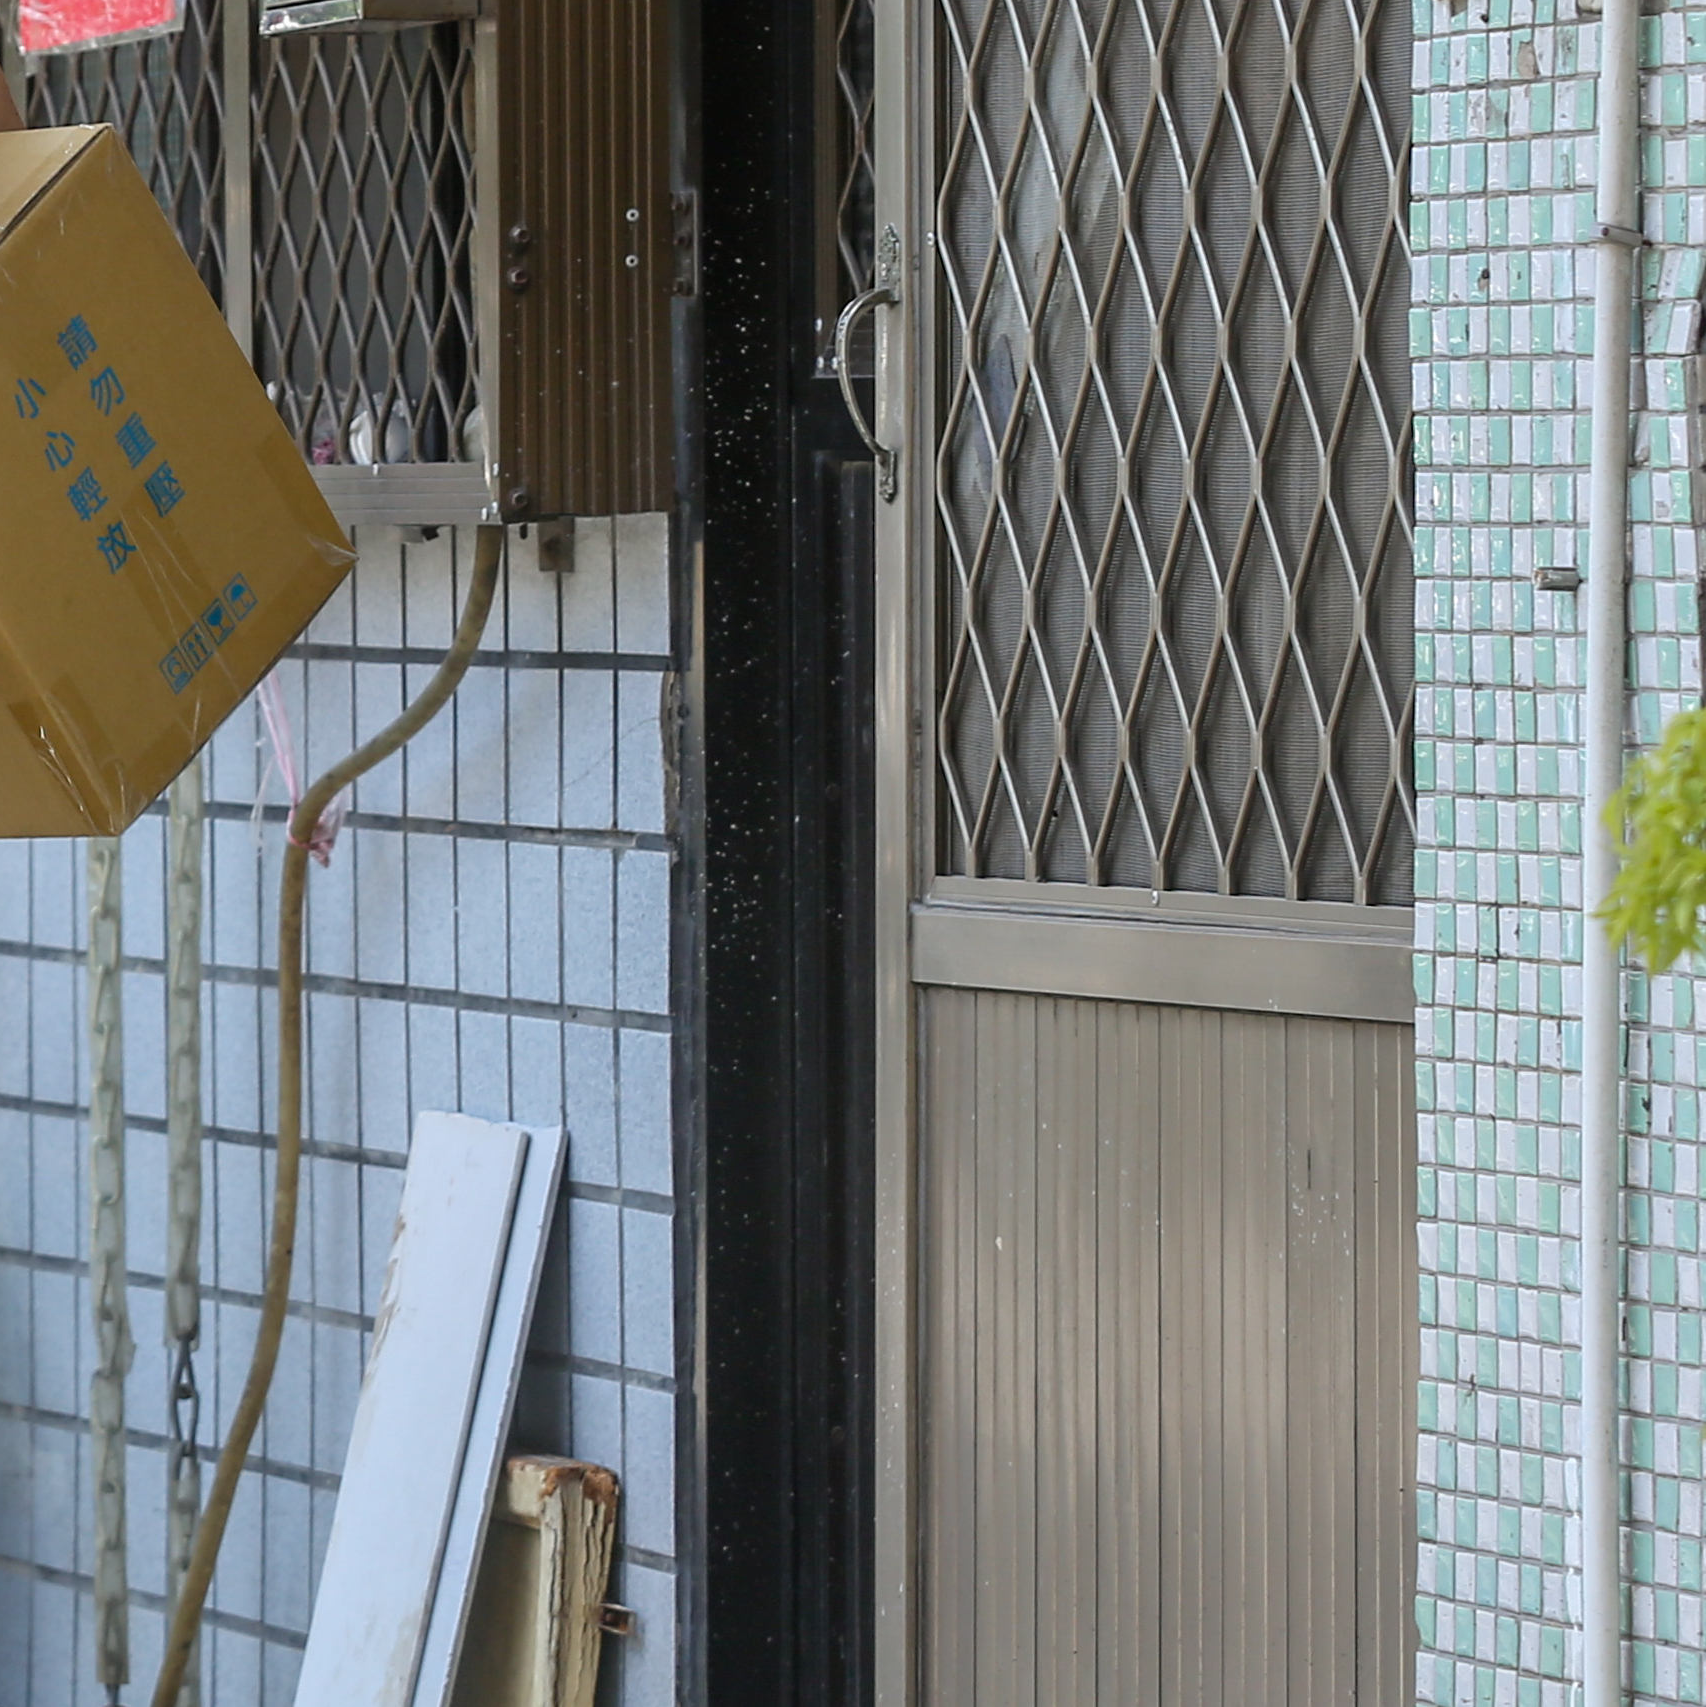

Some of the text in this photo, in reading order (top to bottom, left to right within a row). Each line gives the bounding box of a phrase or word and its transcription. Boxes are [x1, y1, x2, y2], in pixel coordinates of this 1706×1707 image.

[15, 378, 138, 574] 小心輕放
[57, 314, 186, 518] 請勿重壓
